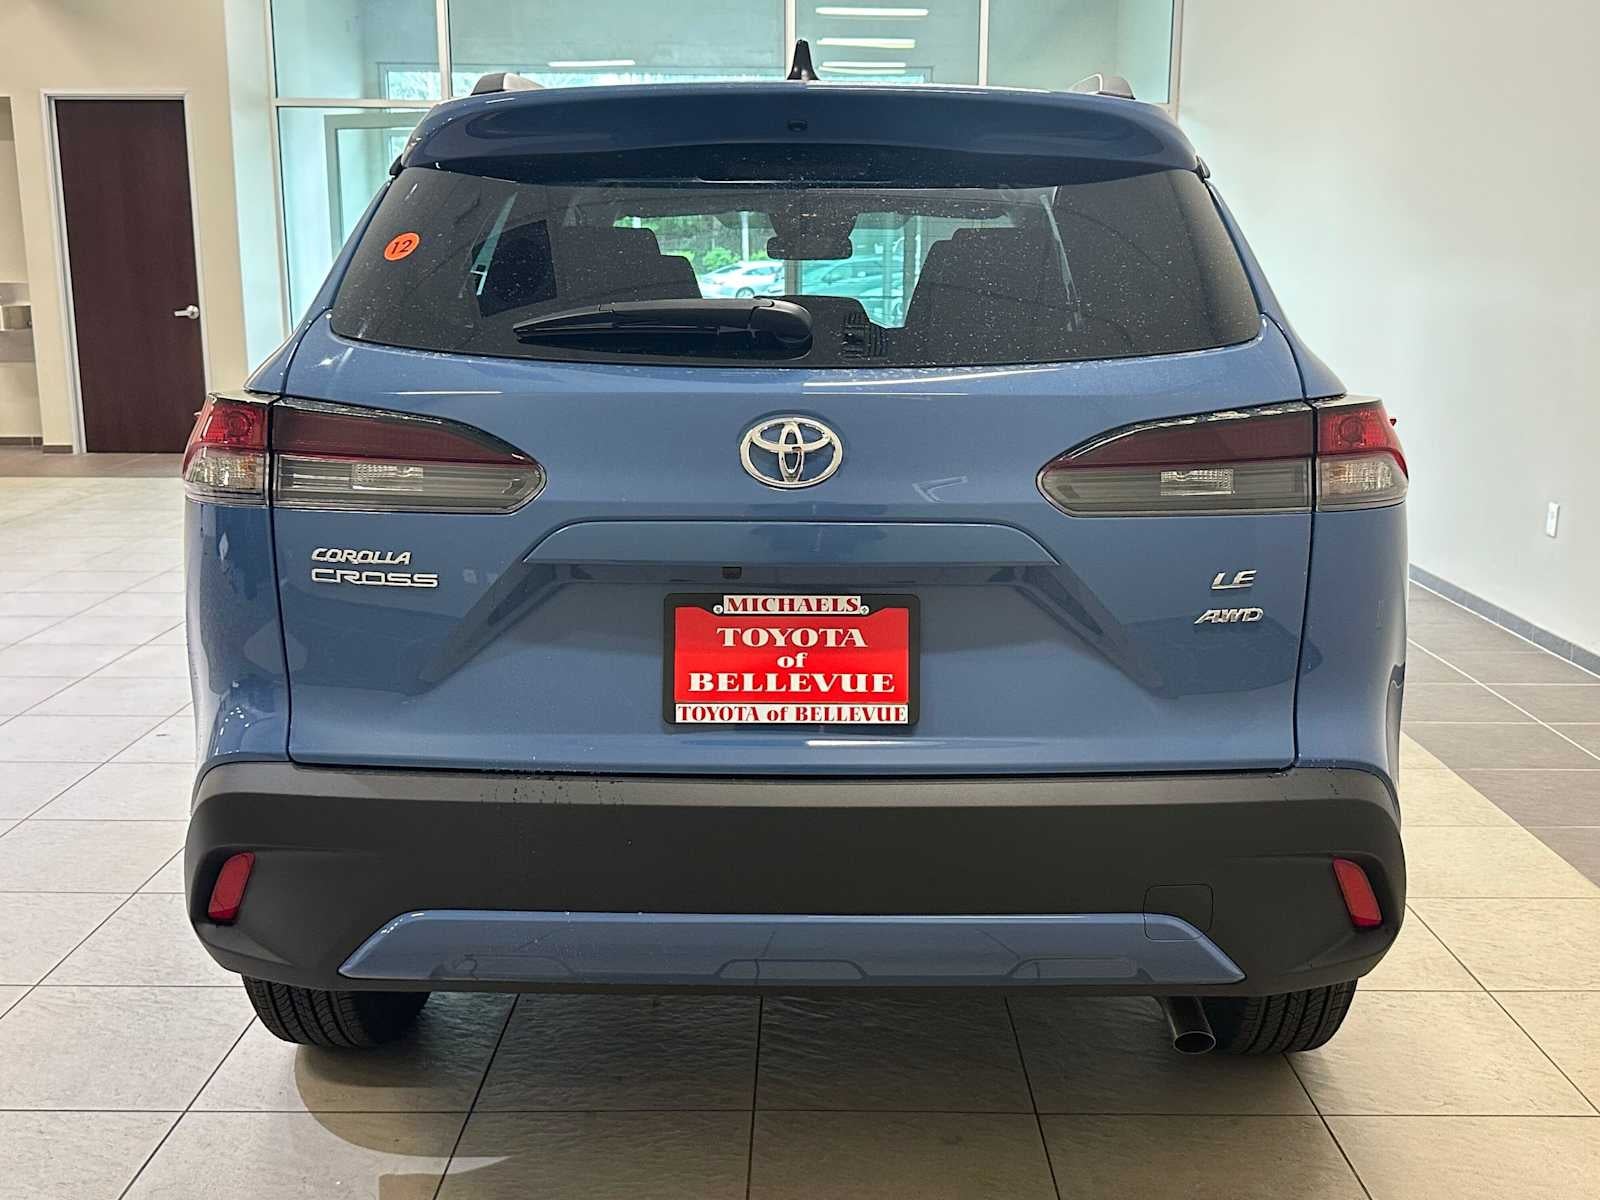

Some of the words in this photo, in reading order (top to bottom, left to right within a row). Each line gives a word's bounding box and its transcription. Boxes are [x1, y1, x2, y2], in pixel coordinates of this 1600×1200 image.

[391, 239, 413, 255] 12
[311, 547, 412, 566] COROLLA
[311, 567, 439, 588] CROSS
[1210, 569, 1257, 590] LE
[727, 597, 859, 613] MICHAELS
[1193, 607, 1264, 625] AWD
[716, 627, 868, 648] TOYOTA
[776, 652, 808, 669] of
[687, 672, 896, 693] BELLEVUE
[677, 705, 760, 722] TOYOTA
[766, 705, 789, 722] of
[794, 705, 908, 723] BELLEVUE
